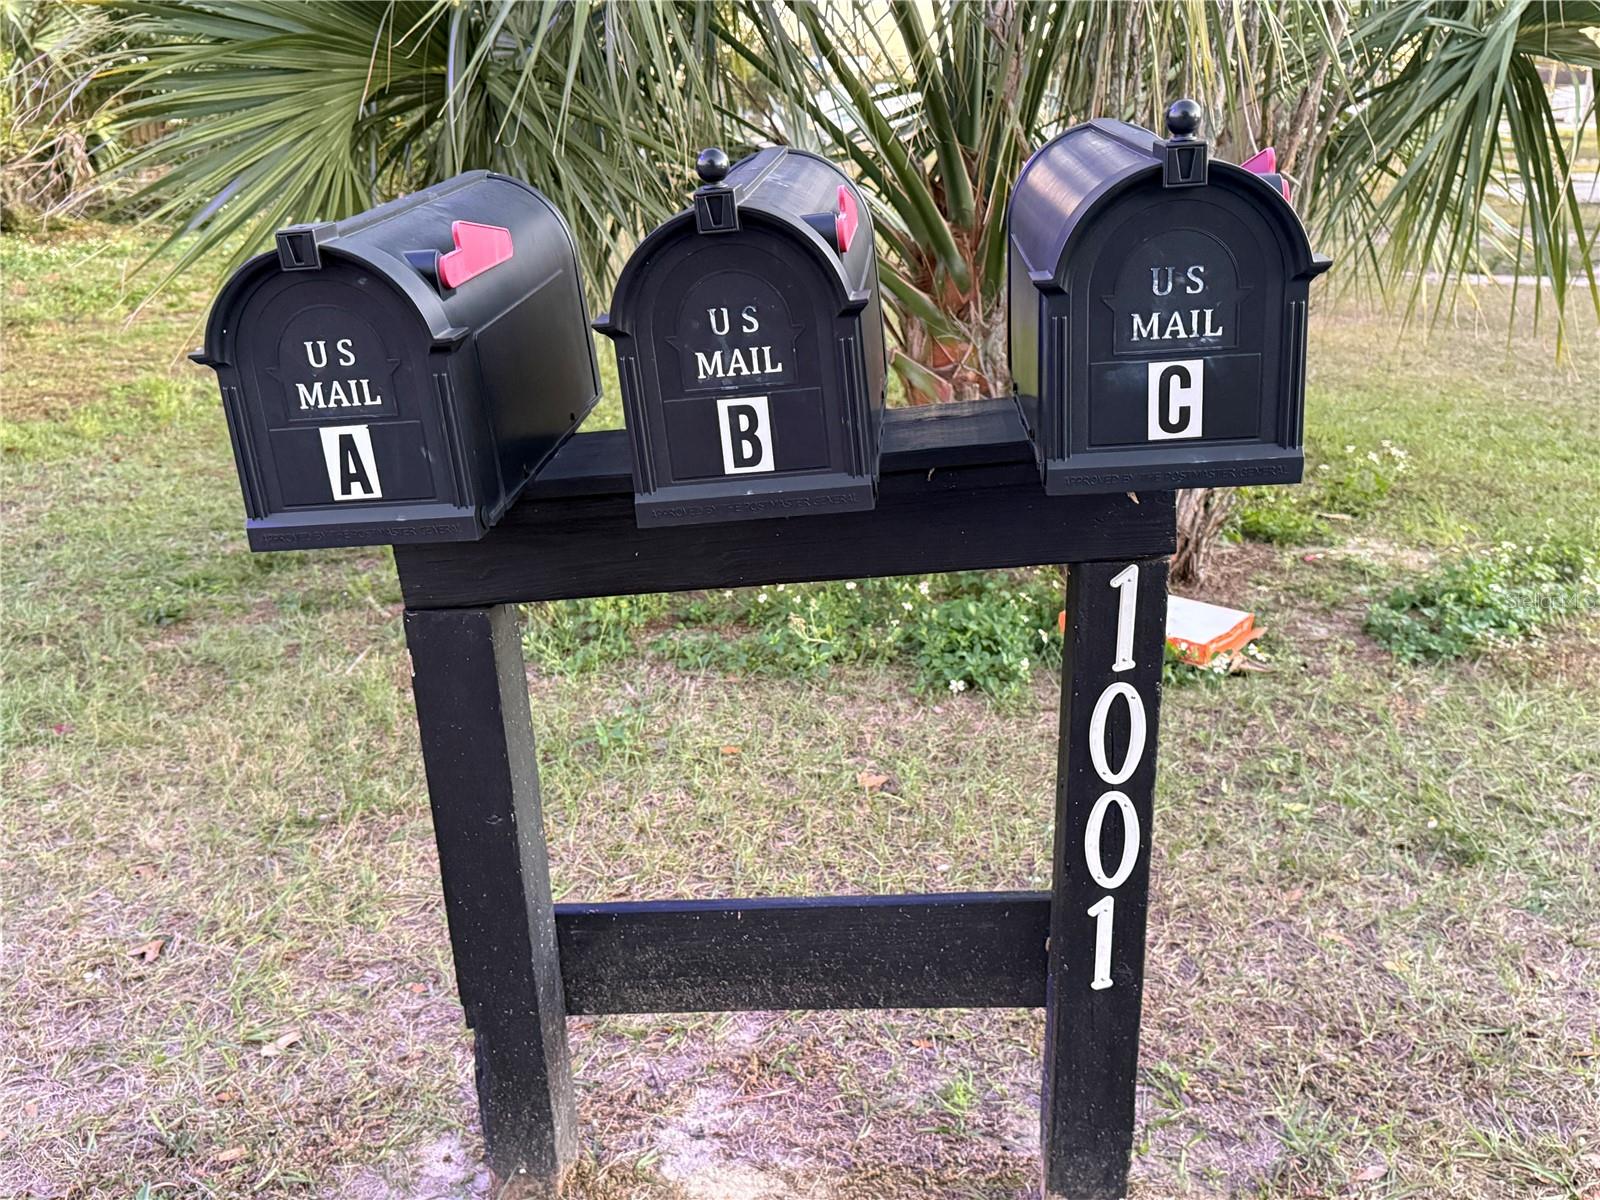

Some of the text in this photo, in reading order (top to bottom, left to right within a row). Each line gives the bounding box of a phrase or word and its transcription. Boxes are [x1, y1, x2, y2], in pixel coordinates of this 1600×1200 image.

[1130, 308, 1223, 341] MAIL
[695, 345, 783, 380] MAIL
[295, 379, 382, 410] MAIL
[1158, 364, 1192, 434] C
[338, 433, 375, 496] A
[726, 403, 763, 469] B
[1084, 563, 1147, 990] 1001
